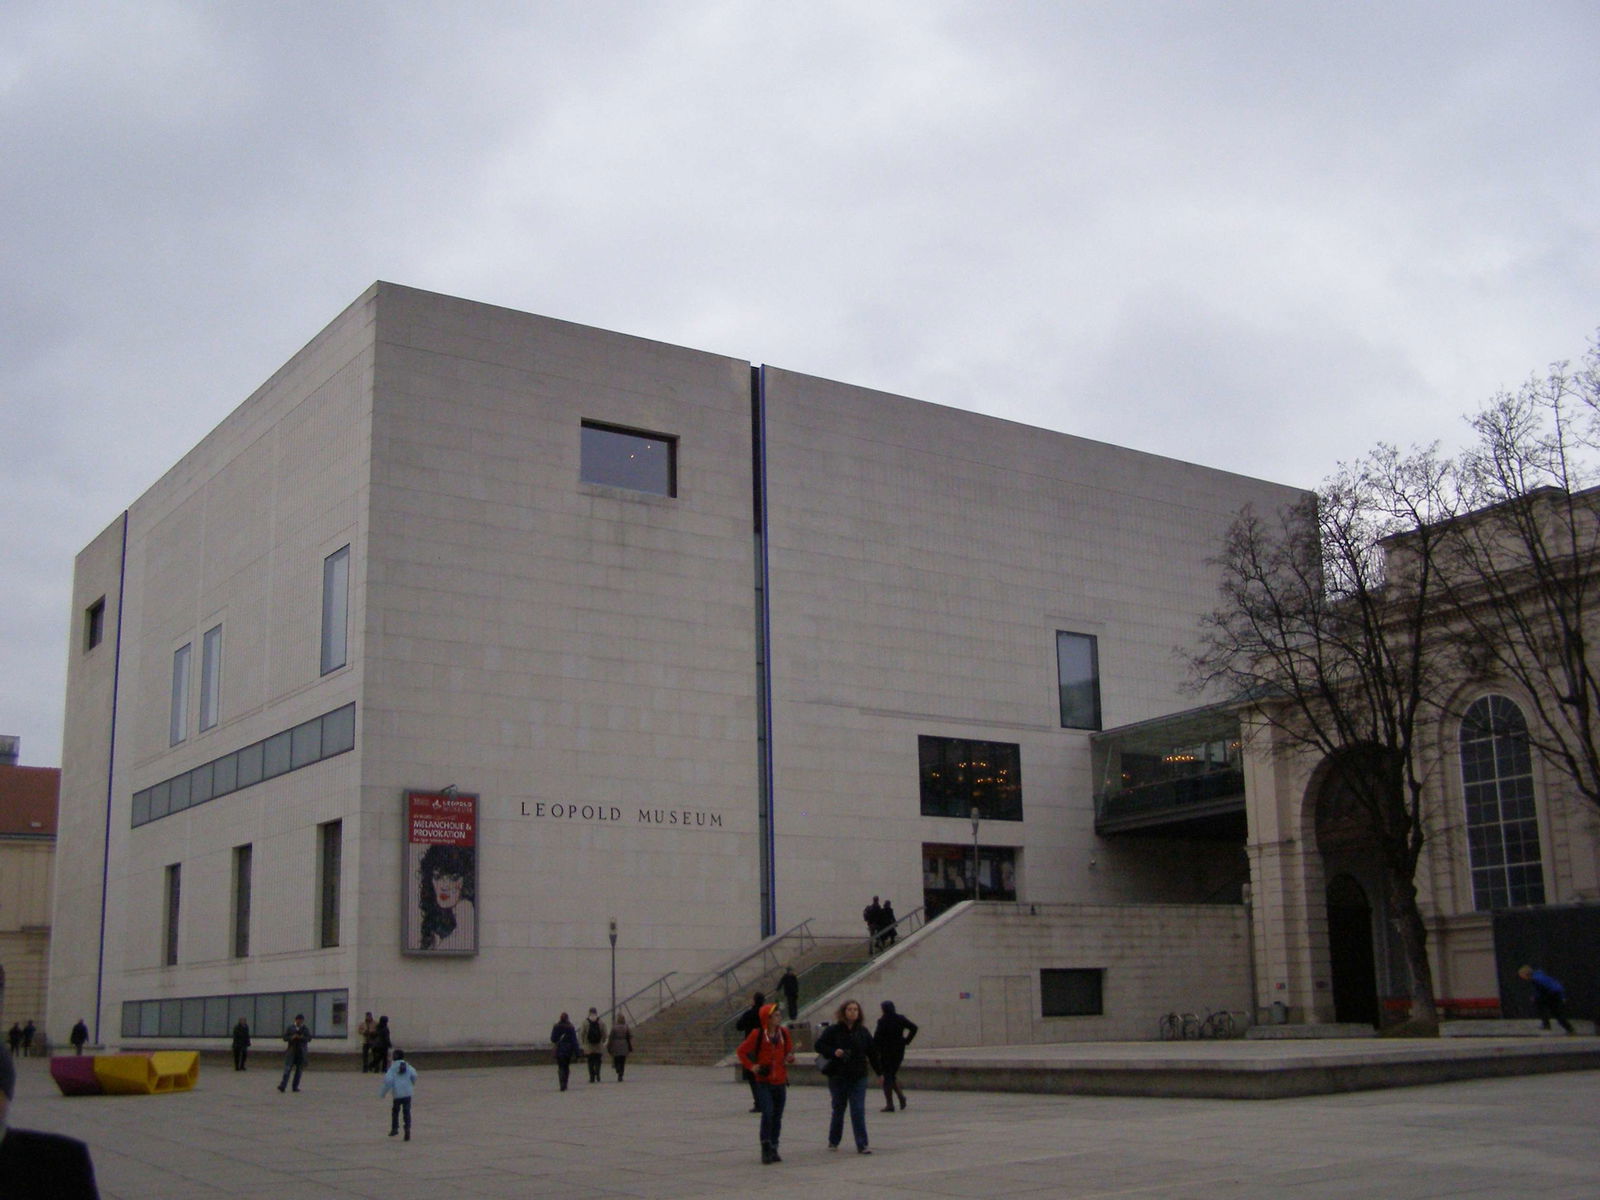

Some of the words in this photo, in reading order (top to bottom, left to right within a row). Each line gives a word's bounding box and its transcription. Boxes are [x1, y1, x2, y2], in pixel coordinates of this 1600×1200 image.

[520, 801, 621, 821] LEOPOLD
[638, 809, 723, 827] MUSEUM
[414, 828, 466, 839] PROVOKATION
